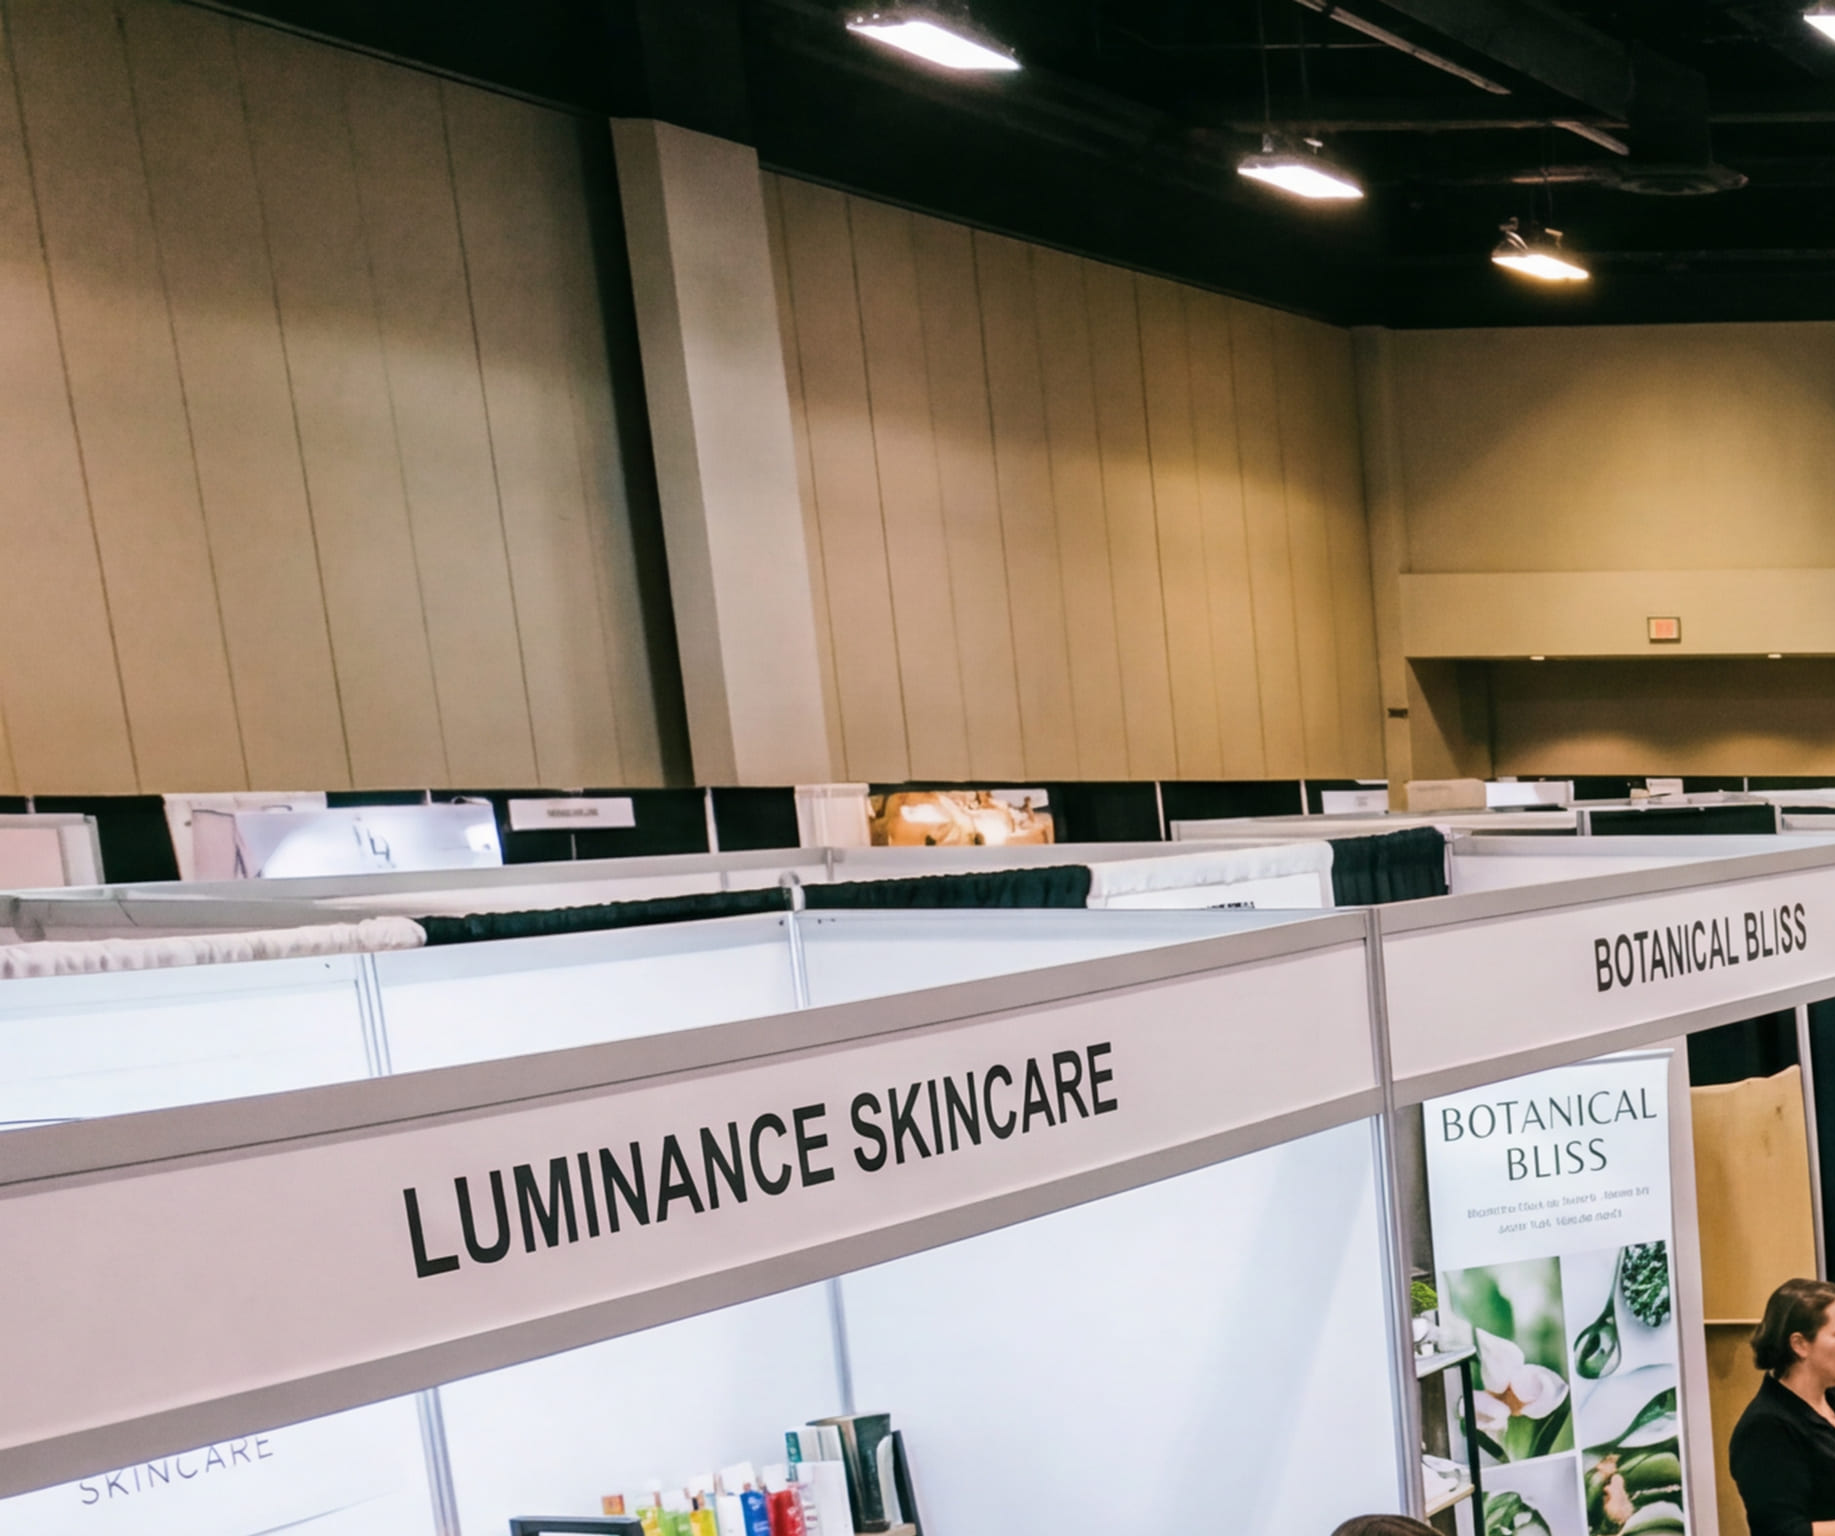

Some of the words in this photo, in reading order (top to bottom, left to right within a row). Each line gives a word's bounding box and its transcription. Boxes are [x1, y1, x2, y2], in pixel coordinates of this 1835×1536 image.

[1595, 917, 1739, 992] BOTANICAL
[1744, 903, 1807, 961] BLISS
[1442, 1087, 1657, 1142] BOTANICAL
[402, 1102, 835, 1279] LUMINANCE
[850, 1041, 1118, 1173] SKINCARE
[1507, 1138, 1608, 1181] BLISS
[79, 1436, 274, 1505] SKINCARE
